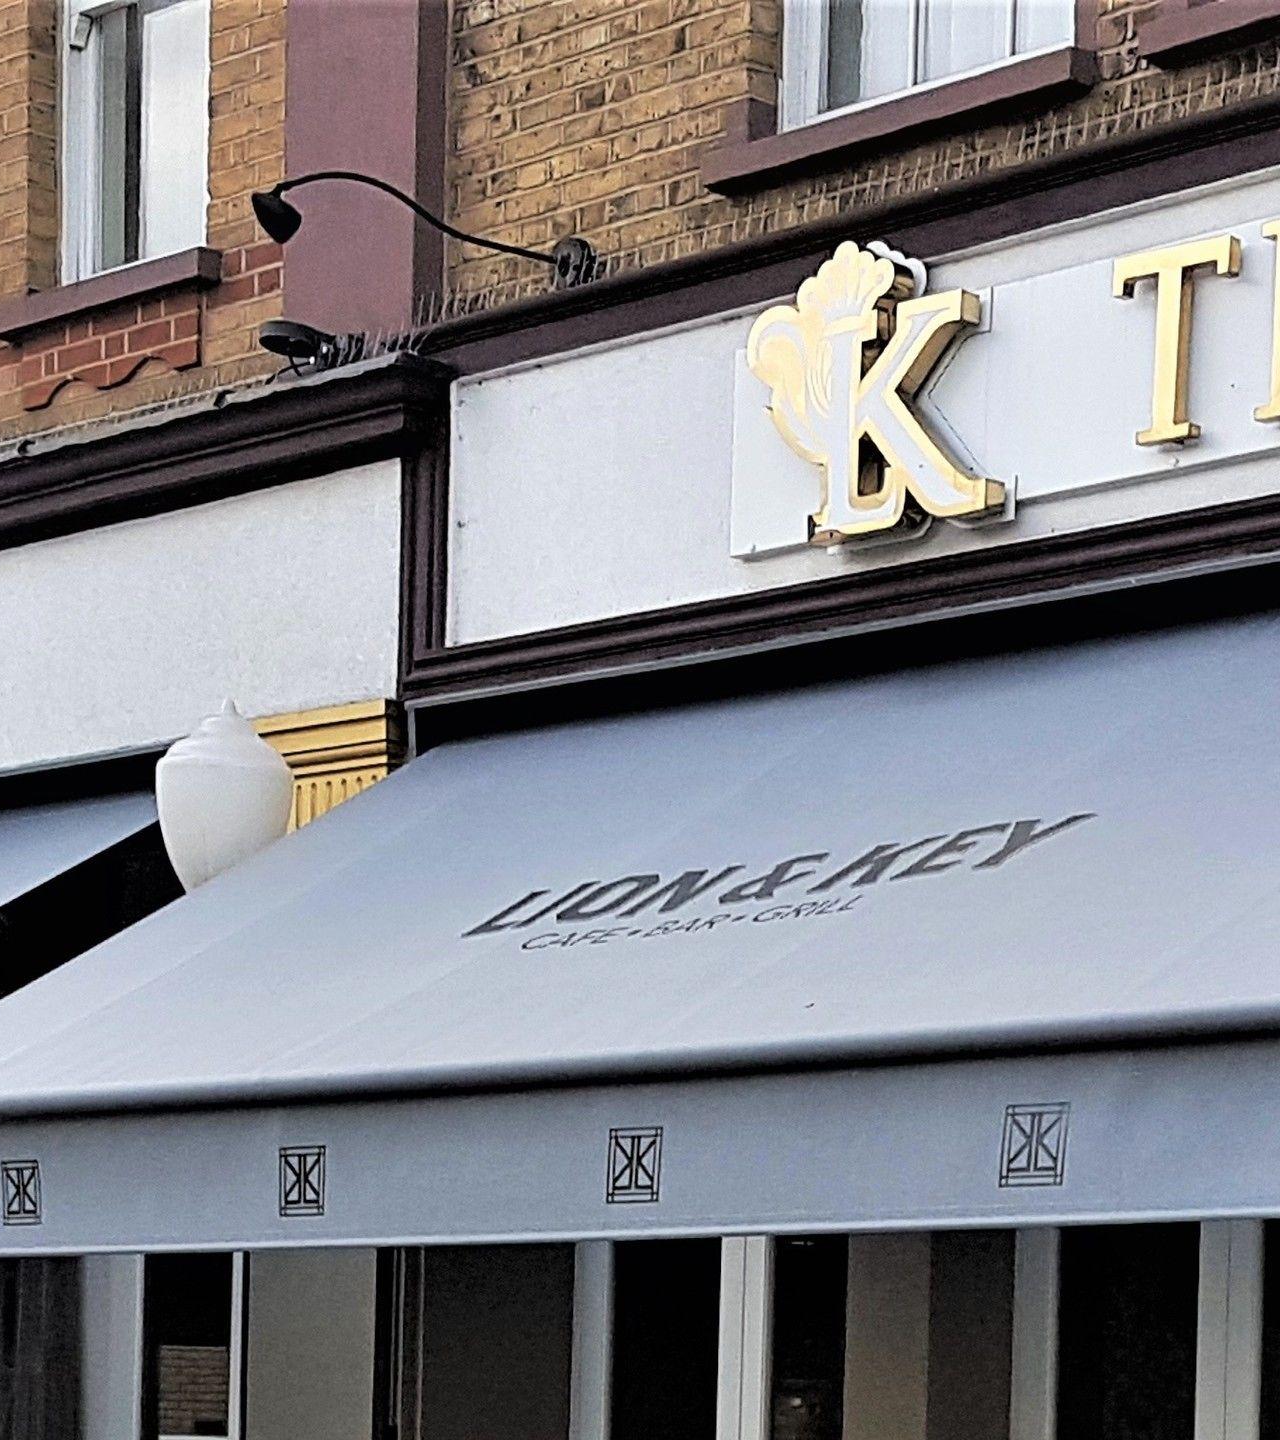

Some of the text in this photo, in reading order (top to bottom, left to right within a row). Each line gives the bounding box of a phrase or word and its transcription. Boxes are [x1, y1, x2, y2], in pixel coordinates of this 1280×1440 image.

[461, 811, 1099, 938] LION & KEY
[642, 913, 732, 938] BAR
[752, 894, 864, 923] GRILL
